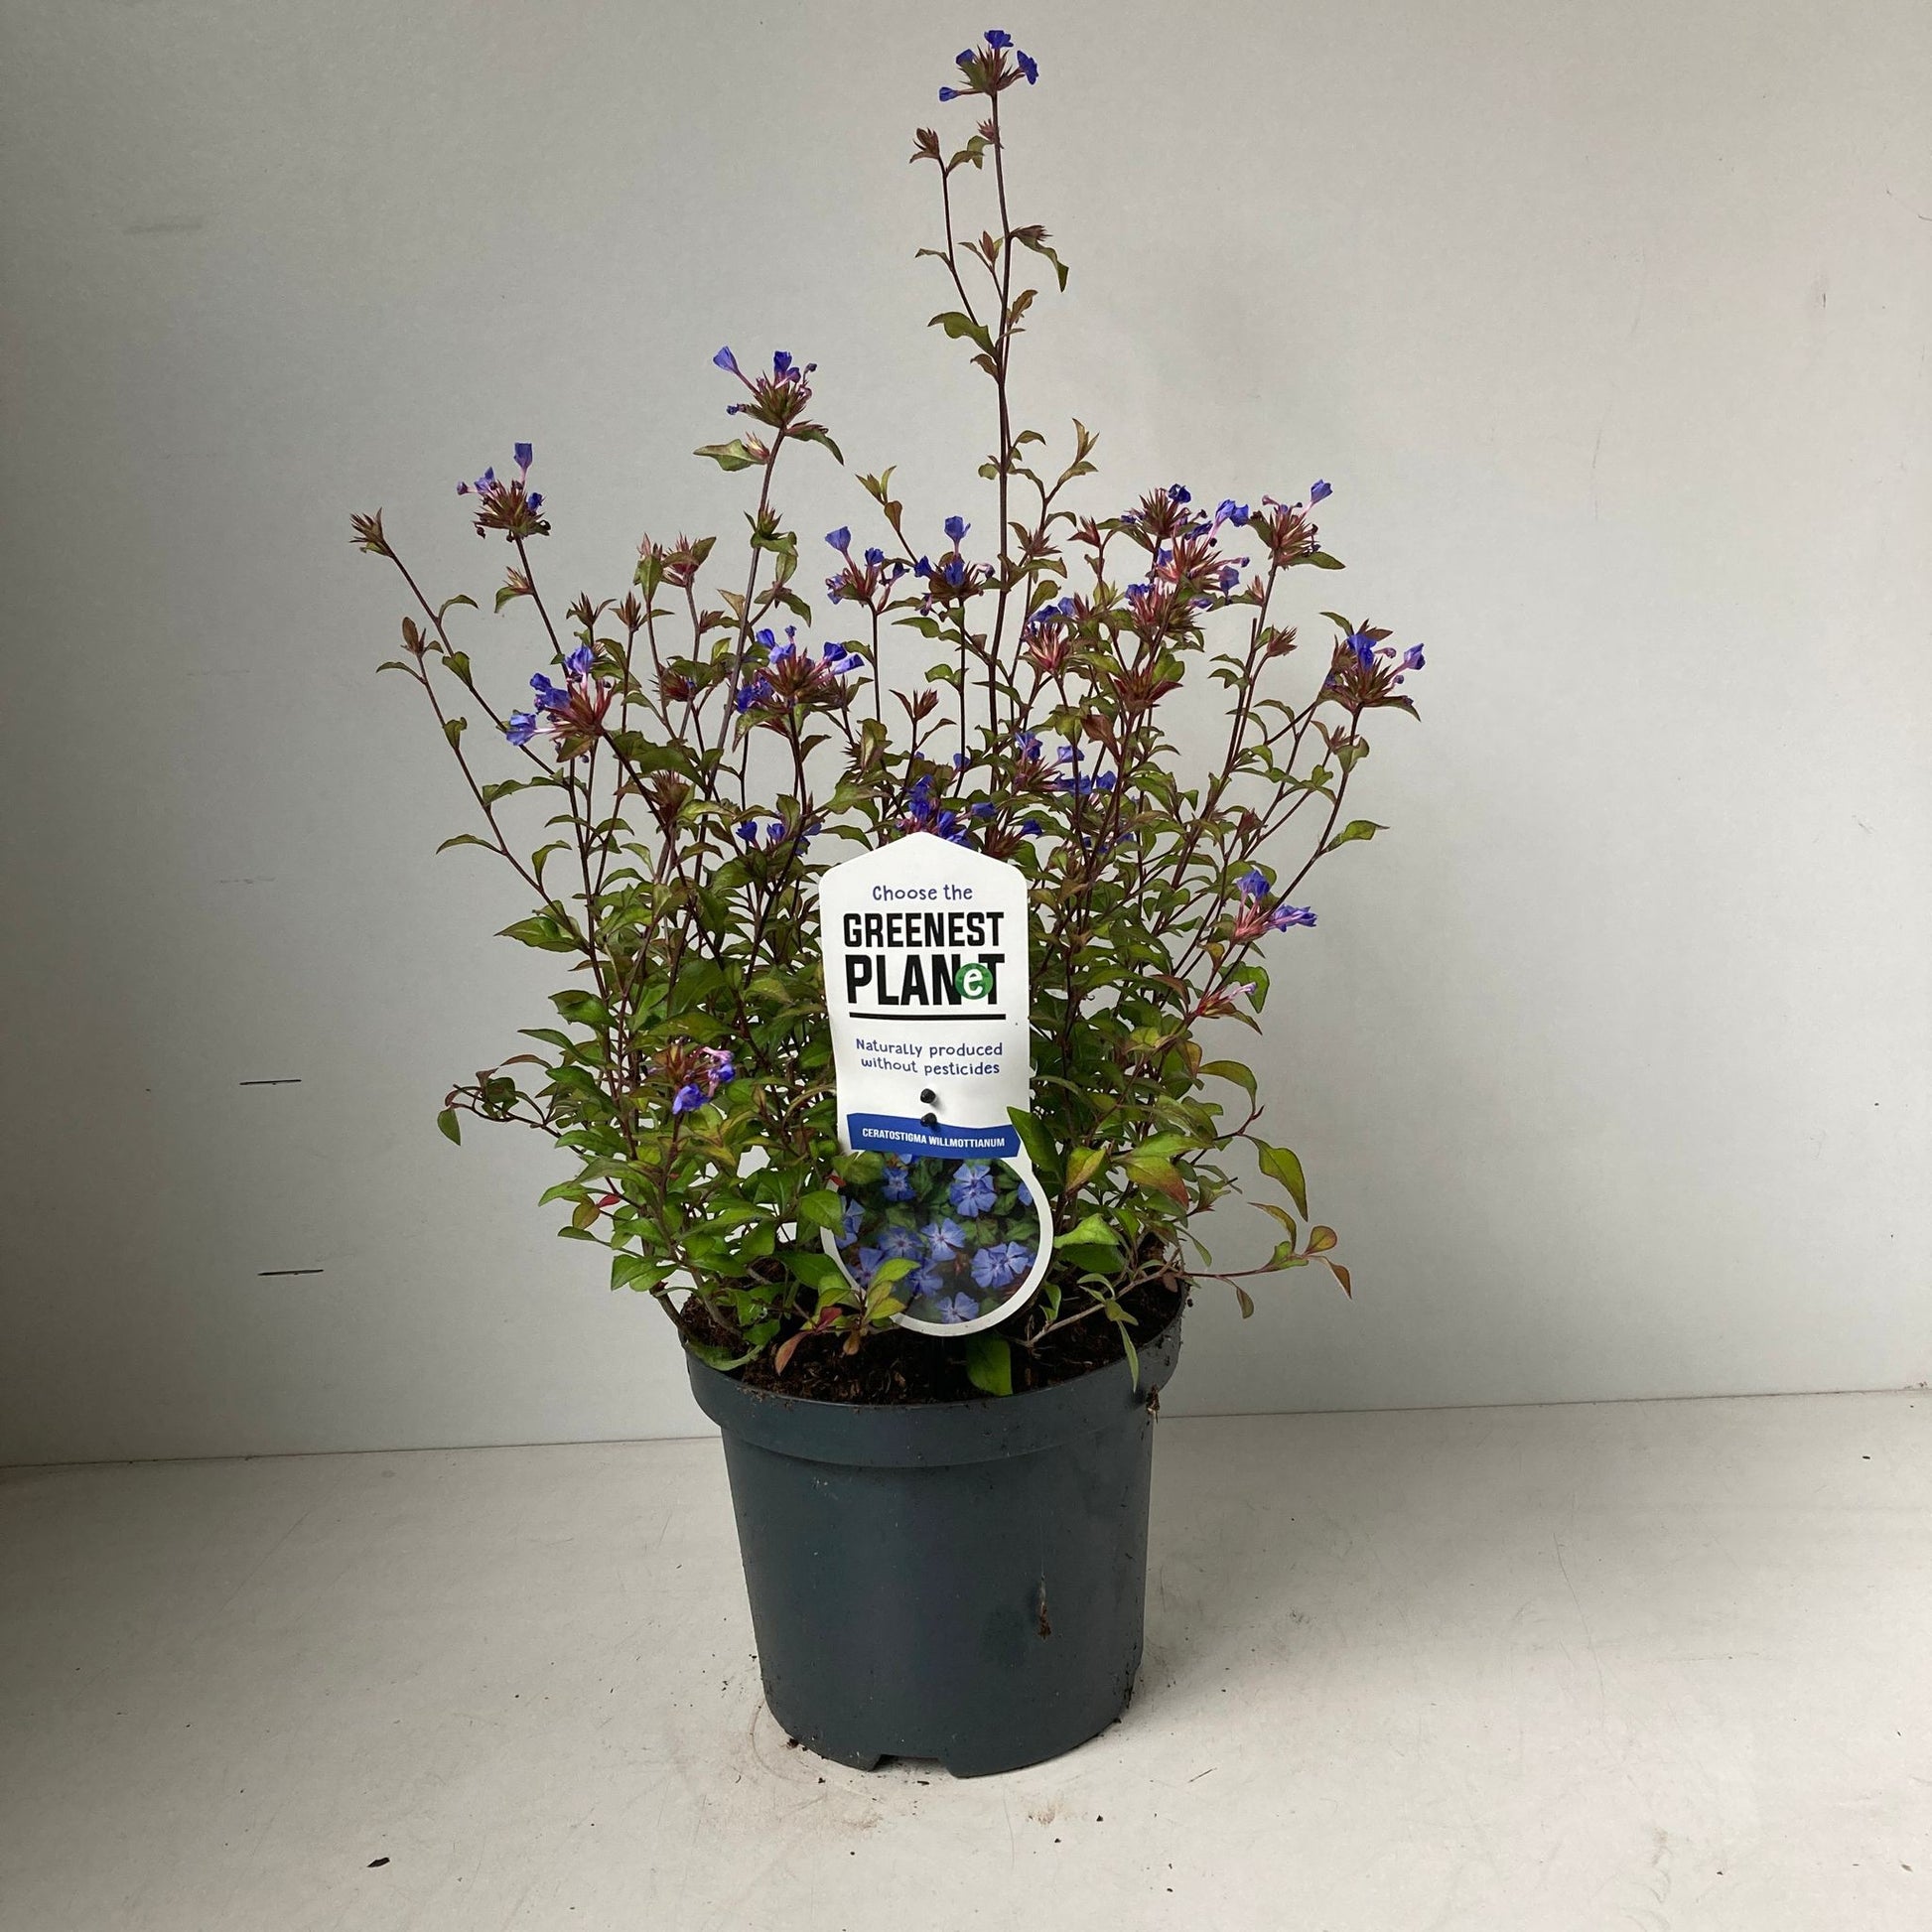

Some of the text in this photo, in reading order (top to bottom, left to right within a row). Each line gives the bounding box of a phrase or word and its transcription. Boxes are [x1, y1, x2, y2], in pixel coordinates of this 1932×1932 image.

[873, 885, 973, 900] Choose the
[844, 911, 1004, 947] GREENEST
[856, 1038, 1003, 1058] Naturally produced
[861, 1057, 1000, 1076] without pesticides
[862, 1128, 1006, 1148] CERATOSTIGMA WILLMOTTIANUM
